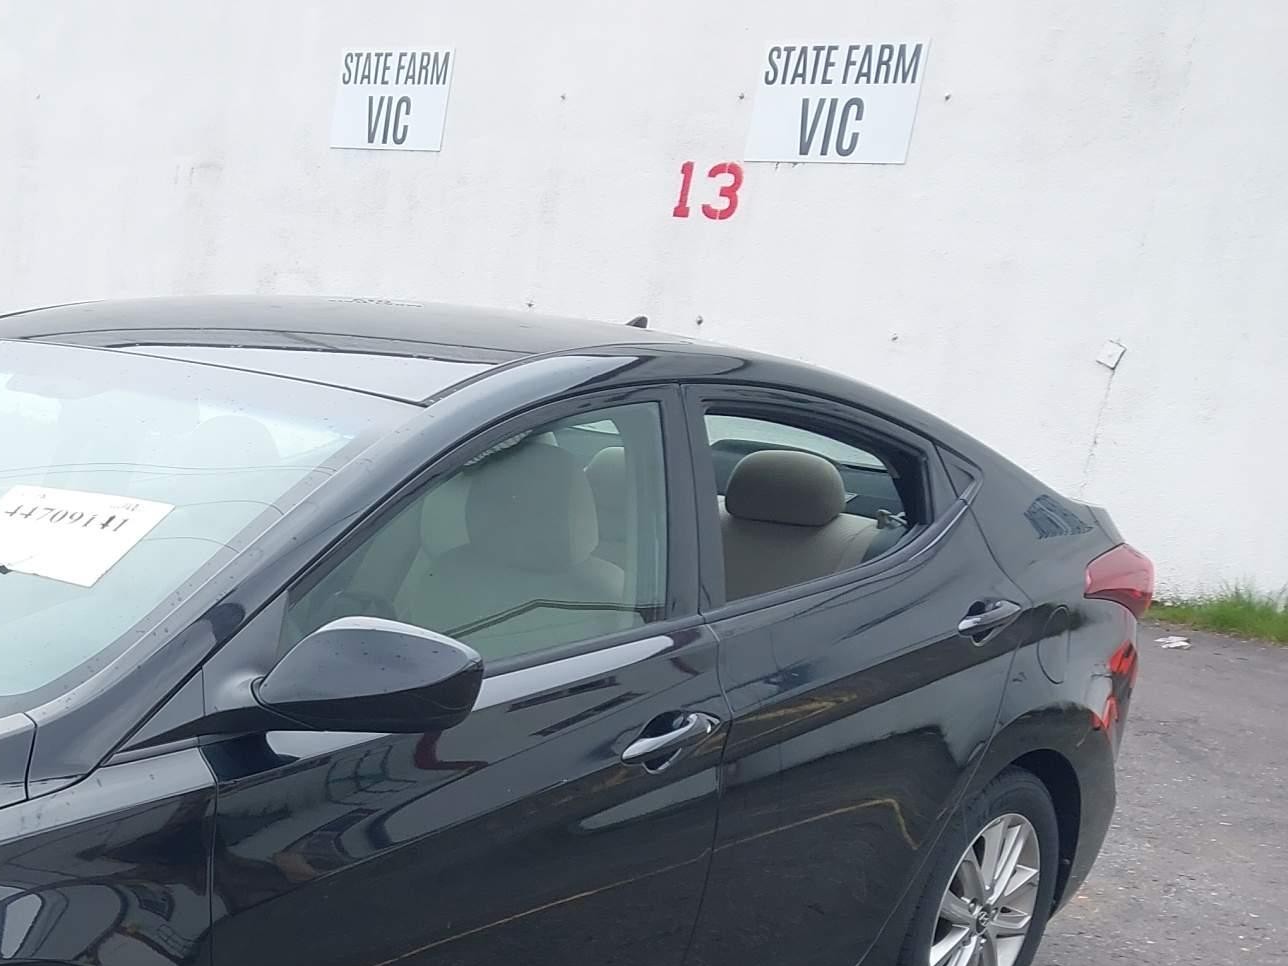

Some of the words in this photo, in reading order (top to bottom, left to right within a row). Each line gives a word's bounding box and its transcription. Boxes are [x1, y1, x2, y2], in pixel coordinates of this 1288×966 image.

[342, 52, 392, 86] STATE
[395, 52, 449, 87] FARM
[764, 45, 839, 86] STATE
[841, 44, 922, 85] FARM
[366, 95, 412, 145] VIC
[797, 97, 865, 157] VIC
[672, 161, 745, 221] 13
[4, 504, 129, 532] 44709141
